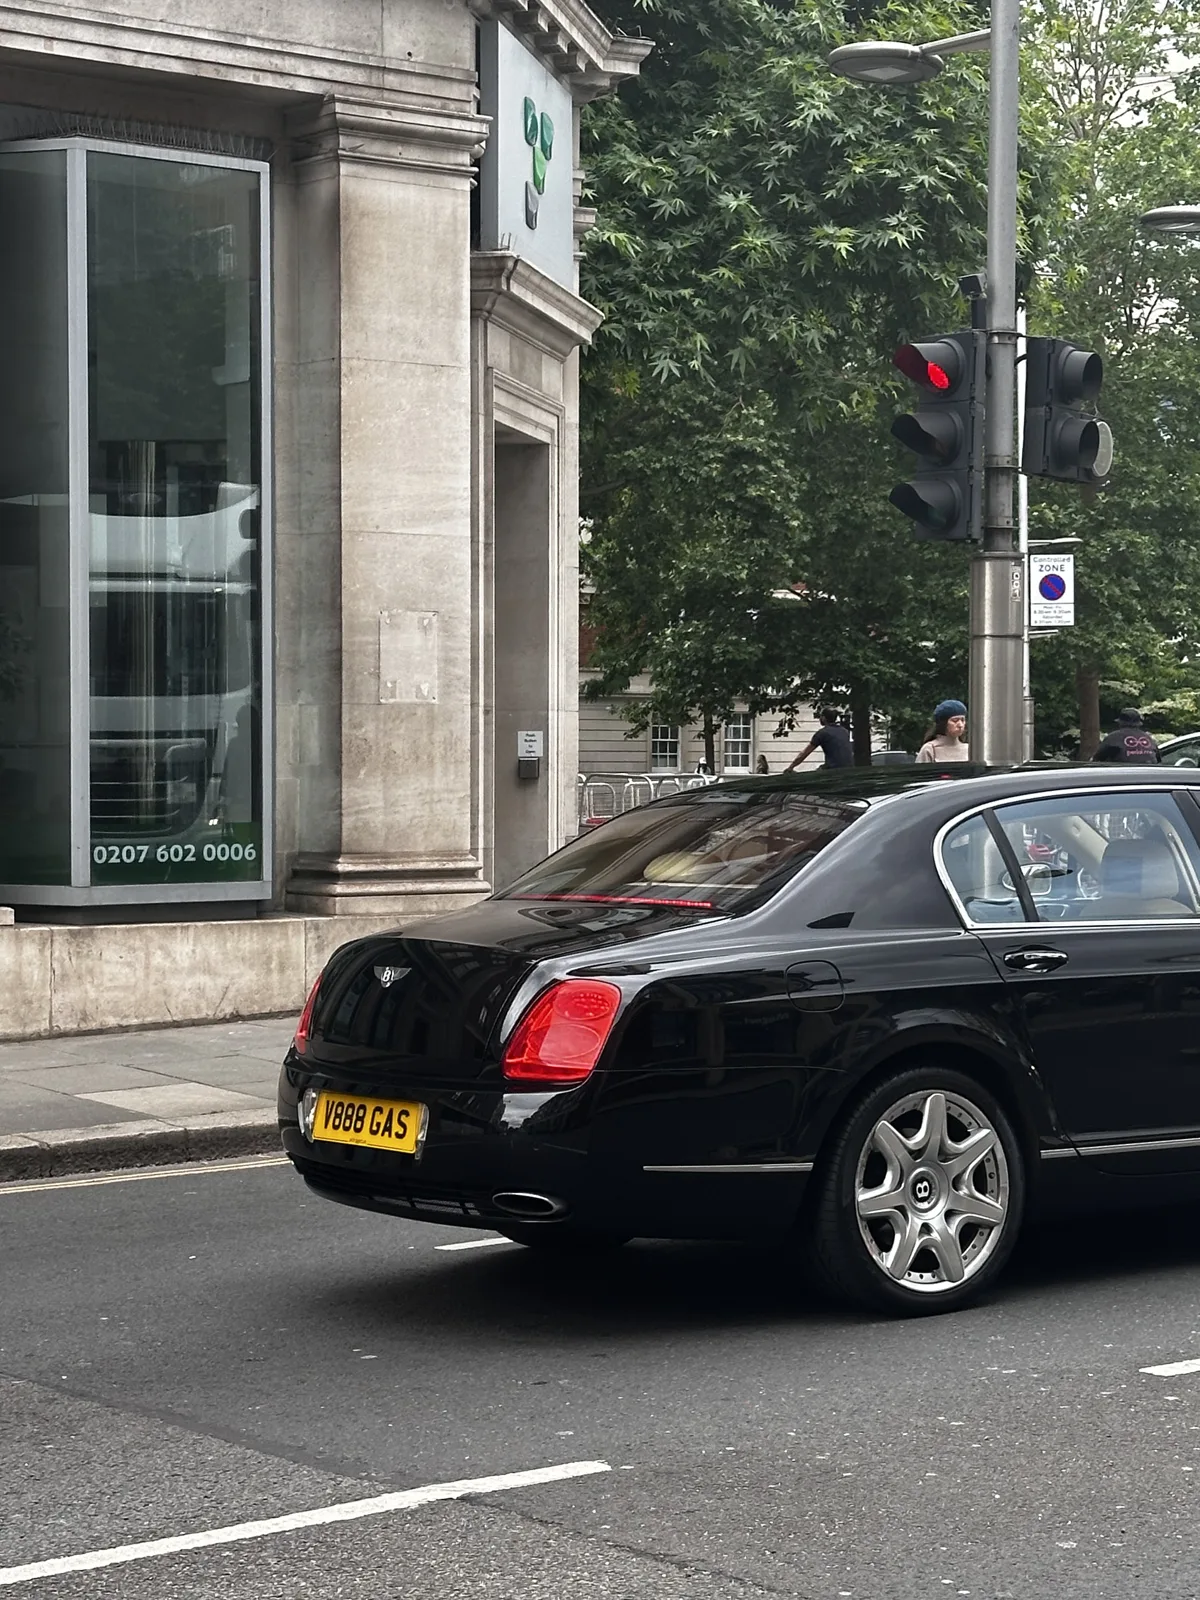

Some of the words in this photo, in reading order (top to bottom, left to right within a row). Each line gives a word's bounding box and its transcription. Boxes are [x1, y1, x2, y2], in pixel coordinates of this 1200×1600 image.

[1038, 564, 1066, 572] ZONE
[93, 845, 149, 864] 0207
[156, 844, 196, 862] 602
[203, 843, 257, 861] 0006
[324, 1100, 367, 1133] V888
[369, 1106, 410, 1139] GAS
[916, 1181, 930, 1198] B
